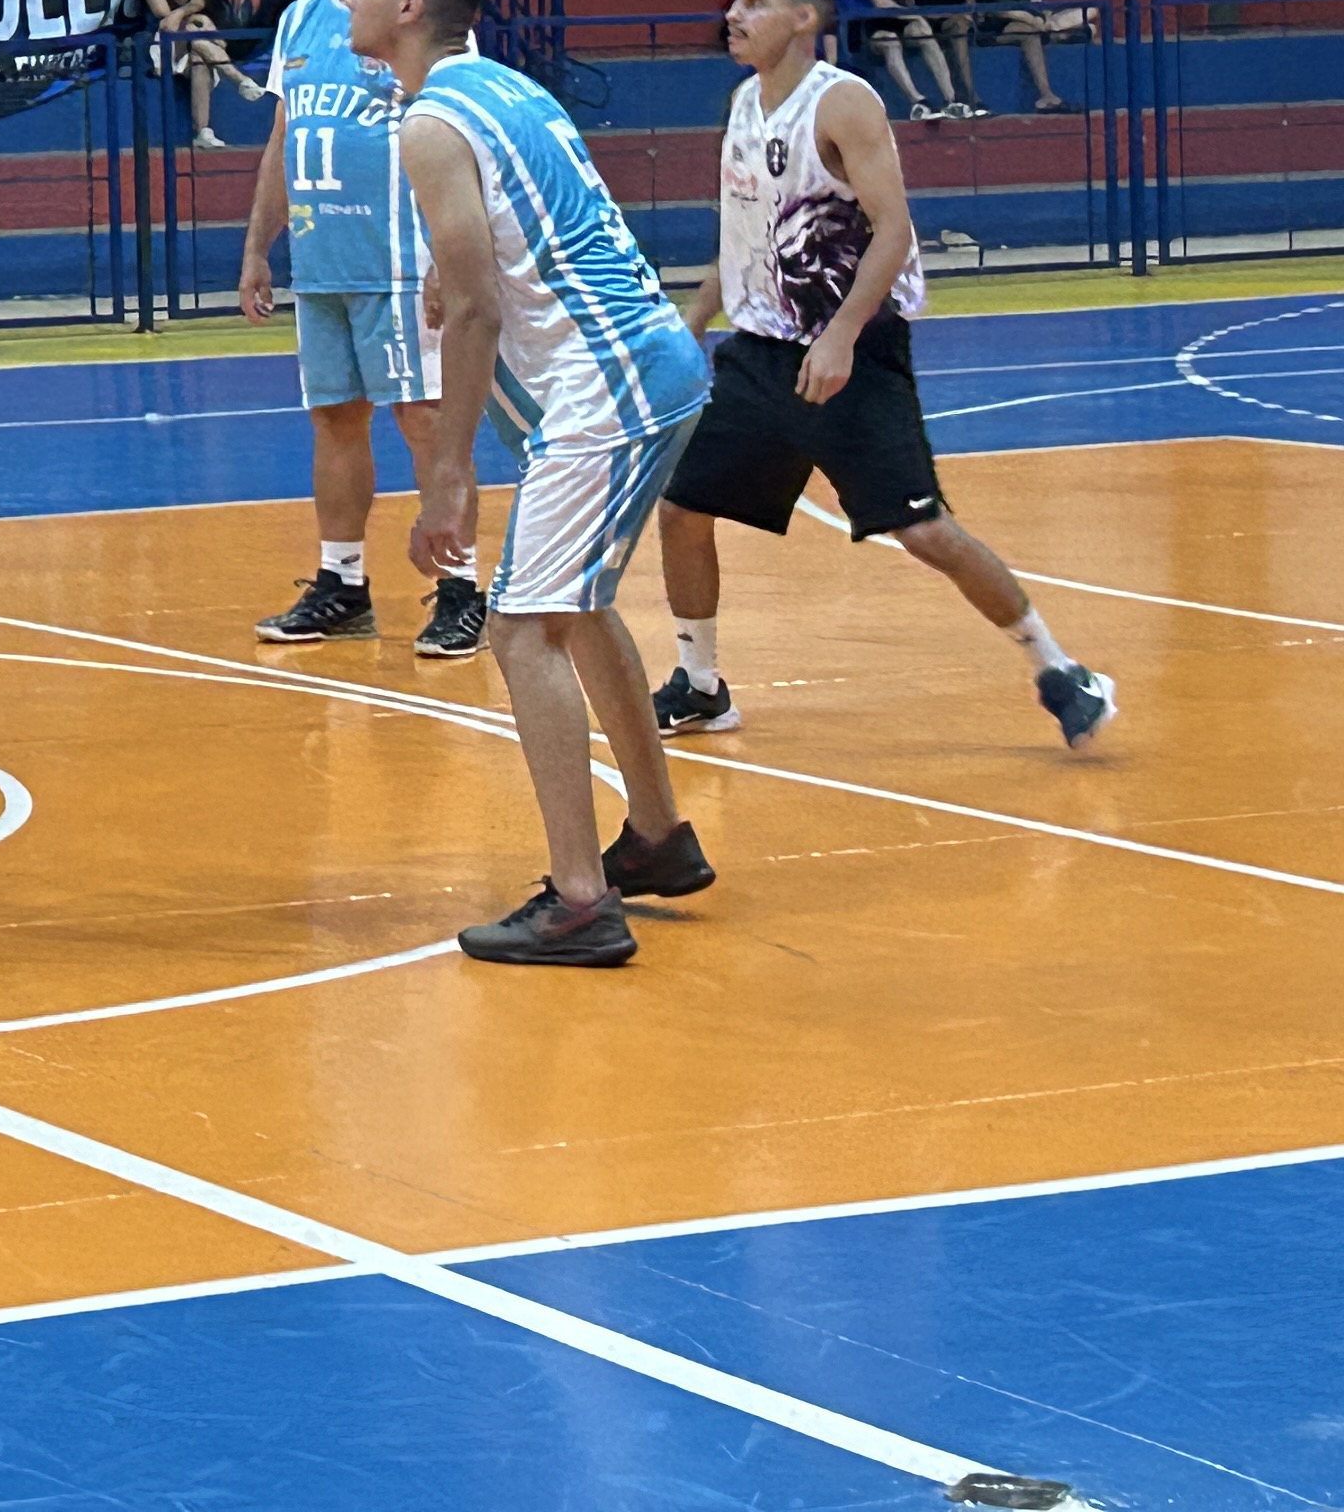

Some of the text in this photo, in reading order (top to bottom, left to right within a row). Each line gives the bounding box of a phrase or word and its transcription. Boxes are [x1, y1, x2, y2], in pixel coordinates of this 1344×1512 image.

[285, 83, 388, 127] IREITO
[293, 127, 342, 191] 11
[383, 343, 414, 379] 11
